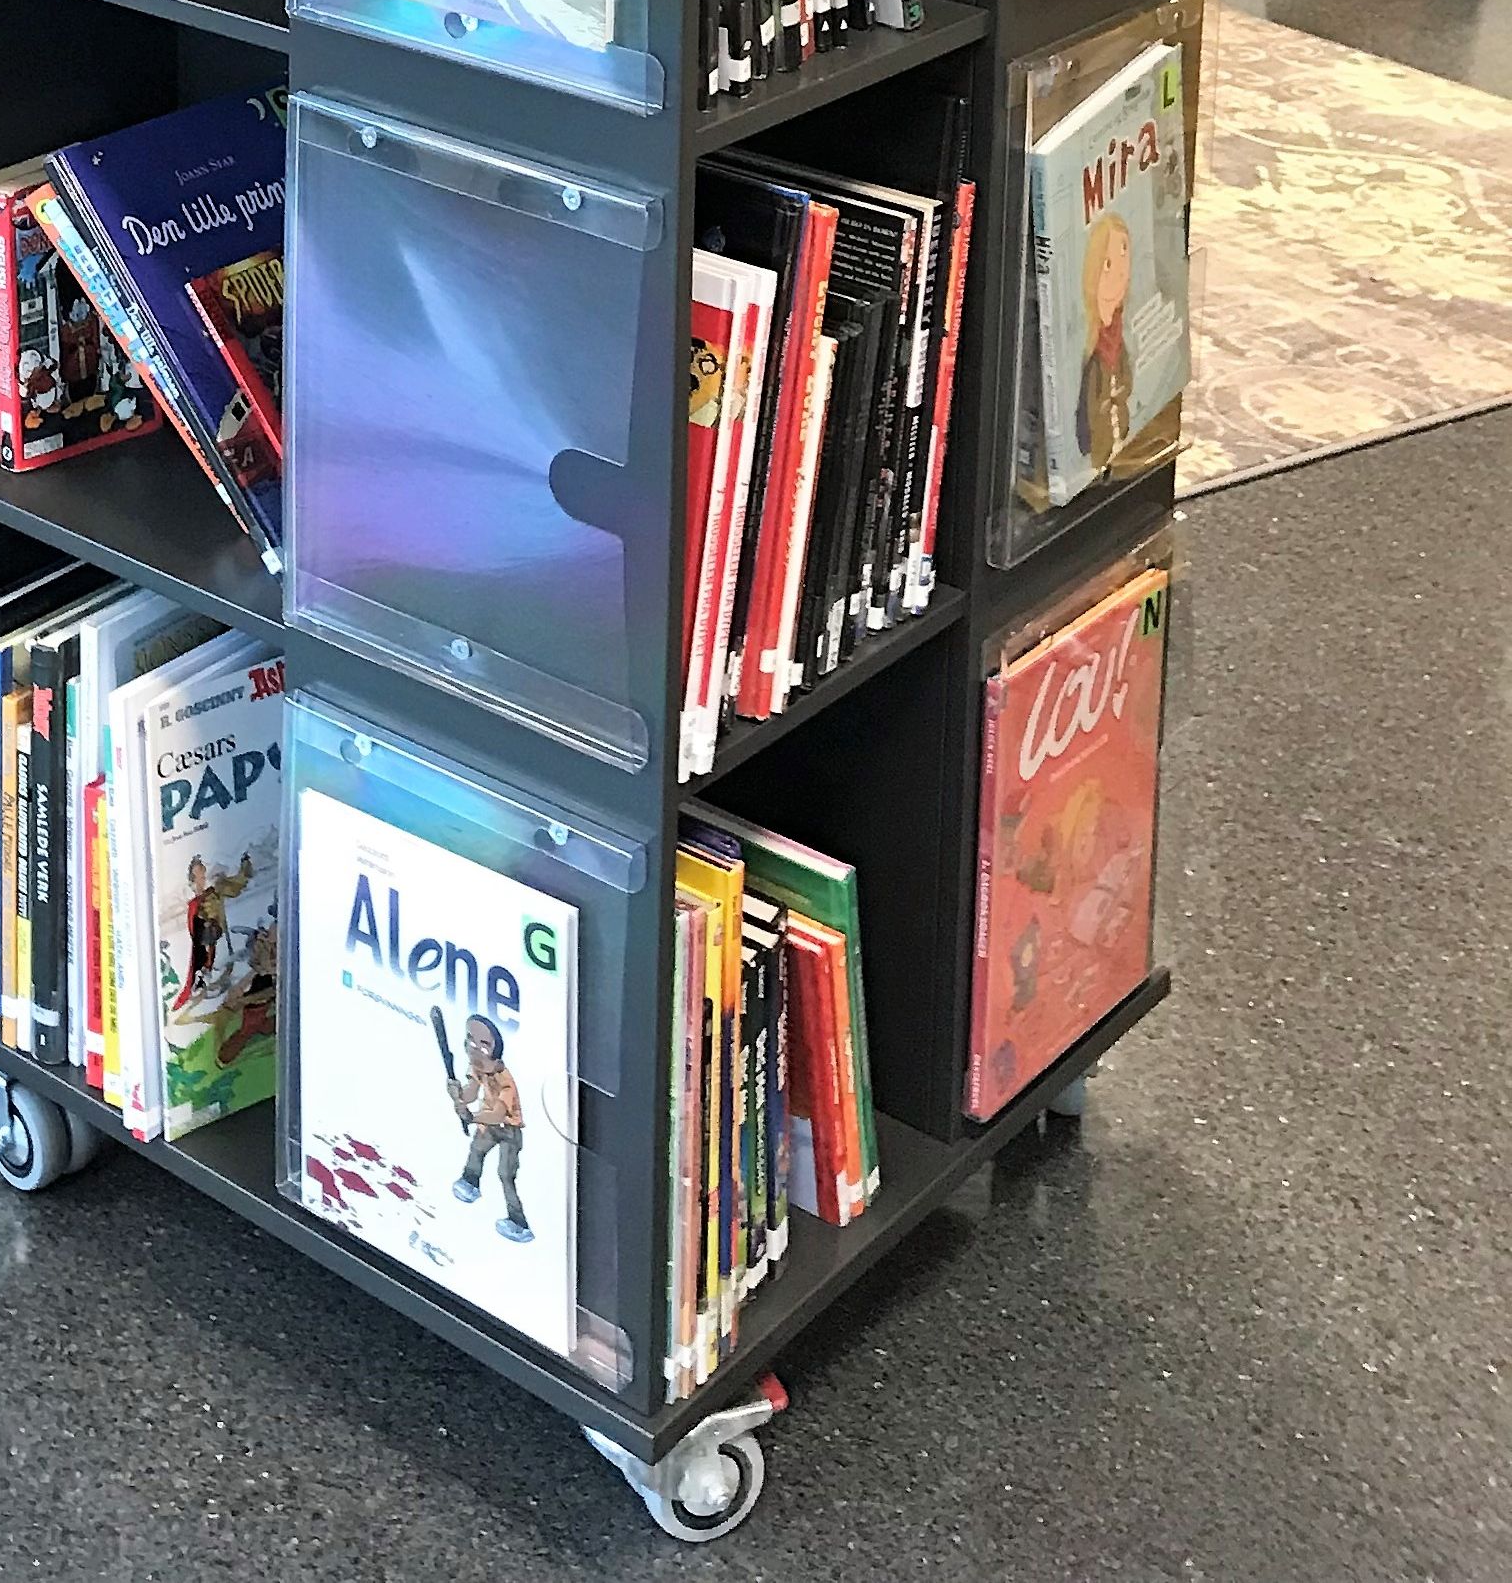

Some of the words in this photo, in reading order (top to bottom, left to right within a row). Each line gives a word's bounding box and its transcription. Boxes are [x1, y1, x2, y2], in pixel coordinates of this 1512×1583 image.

[1162, 70, 1175, 109] L
[1082, 119, 1159, 225] Mira
[121, 215, 186, 256] Den
[181, 193, 237, 234] lille
[235, 177, 286, 232] prin
[922, 213, 942, 323] IDENTITY
[1035, 235, 1054, 275] Mira
[950, 267, 966, 351] SUPERMAN
[1143, 590, 1161, 636] N
[175, 686, 245, 723] GOSCINNY
[156, 732, 237, 779] Cæsars
[36, 782, 49, 856] SAMLEDE
[36, 861, 50, 903] VERK
[345, 873, 520, 1034] Alene
[524, 922, 557, 972] G
